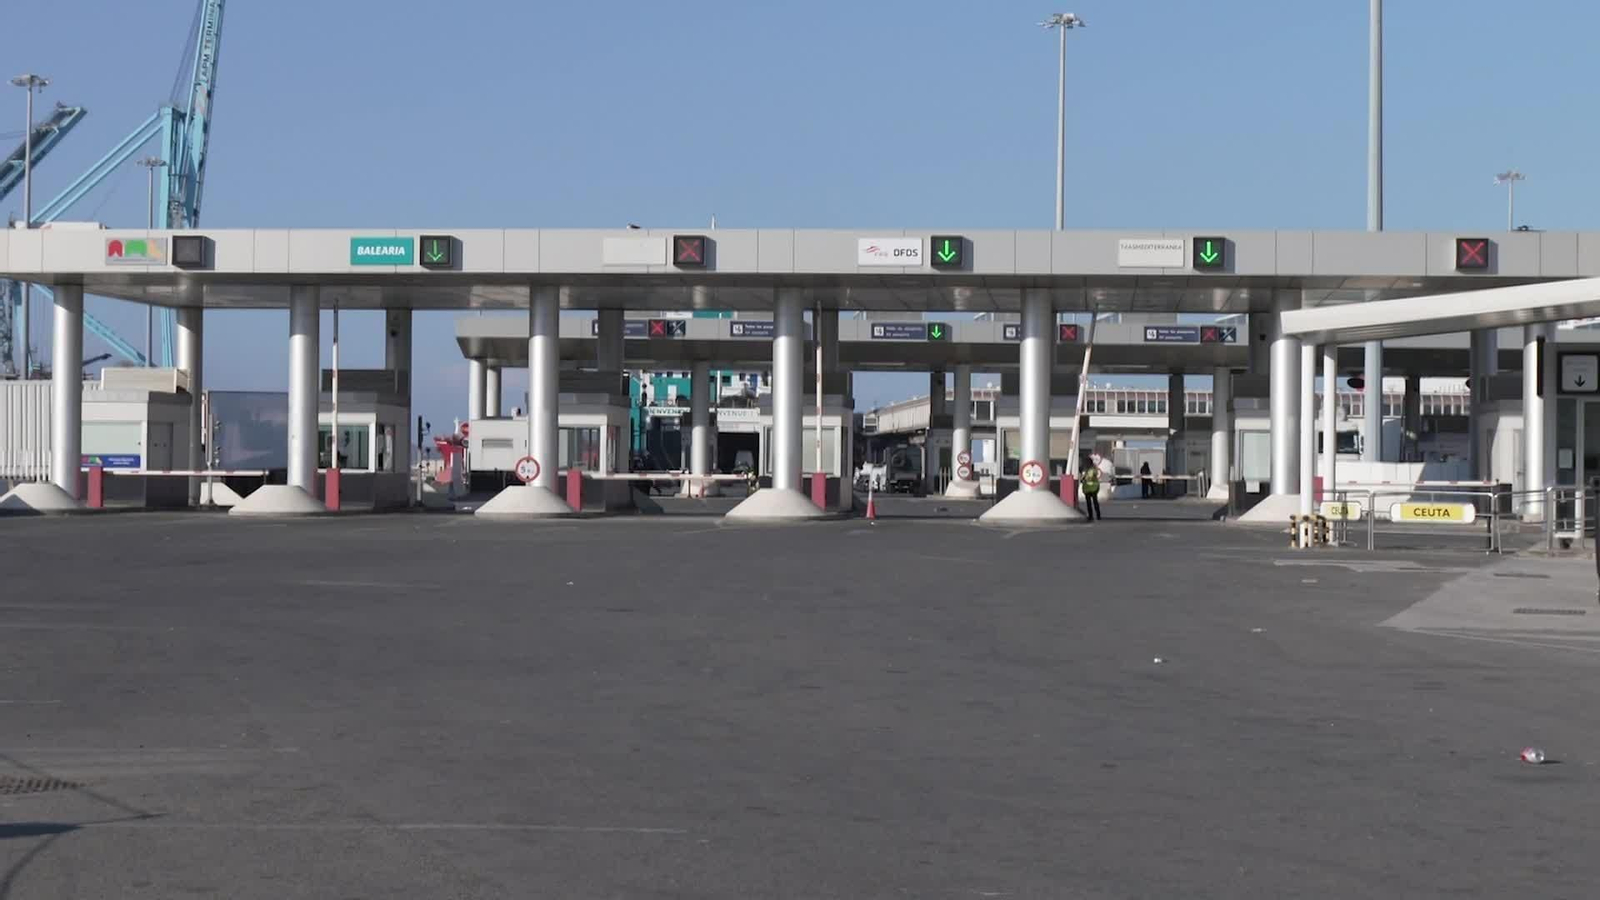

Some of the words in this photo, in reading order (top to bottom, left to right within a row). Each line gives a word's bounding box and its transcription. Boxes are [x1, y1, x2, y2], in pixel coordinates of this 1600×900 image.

[201, 53, 210, 77] APM
[357, 246, 405, 255] BALEARIA
[893, 248, 919, 257] DFDS
[1413, 507, 1451, 517] CEUTA
